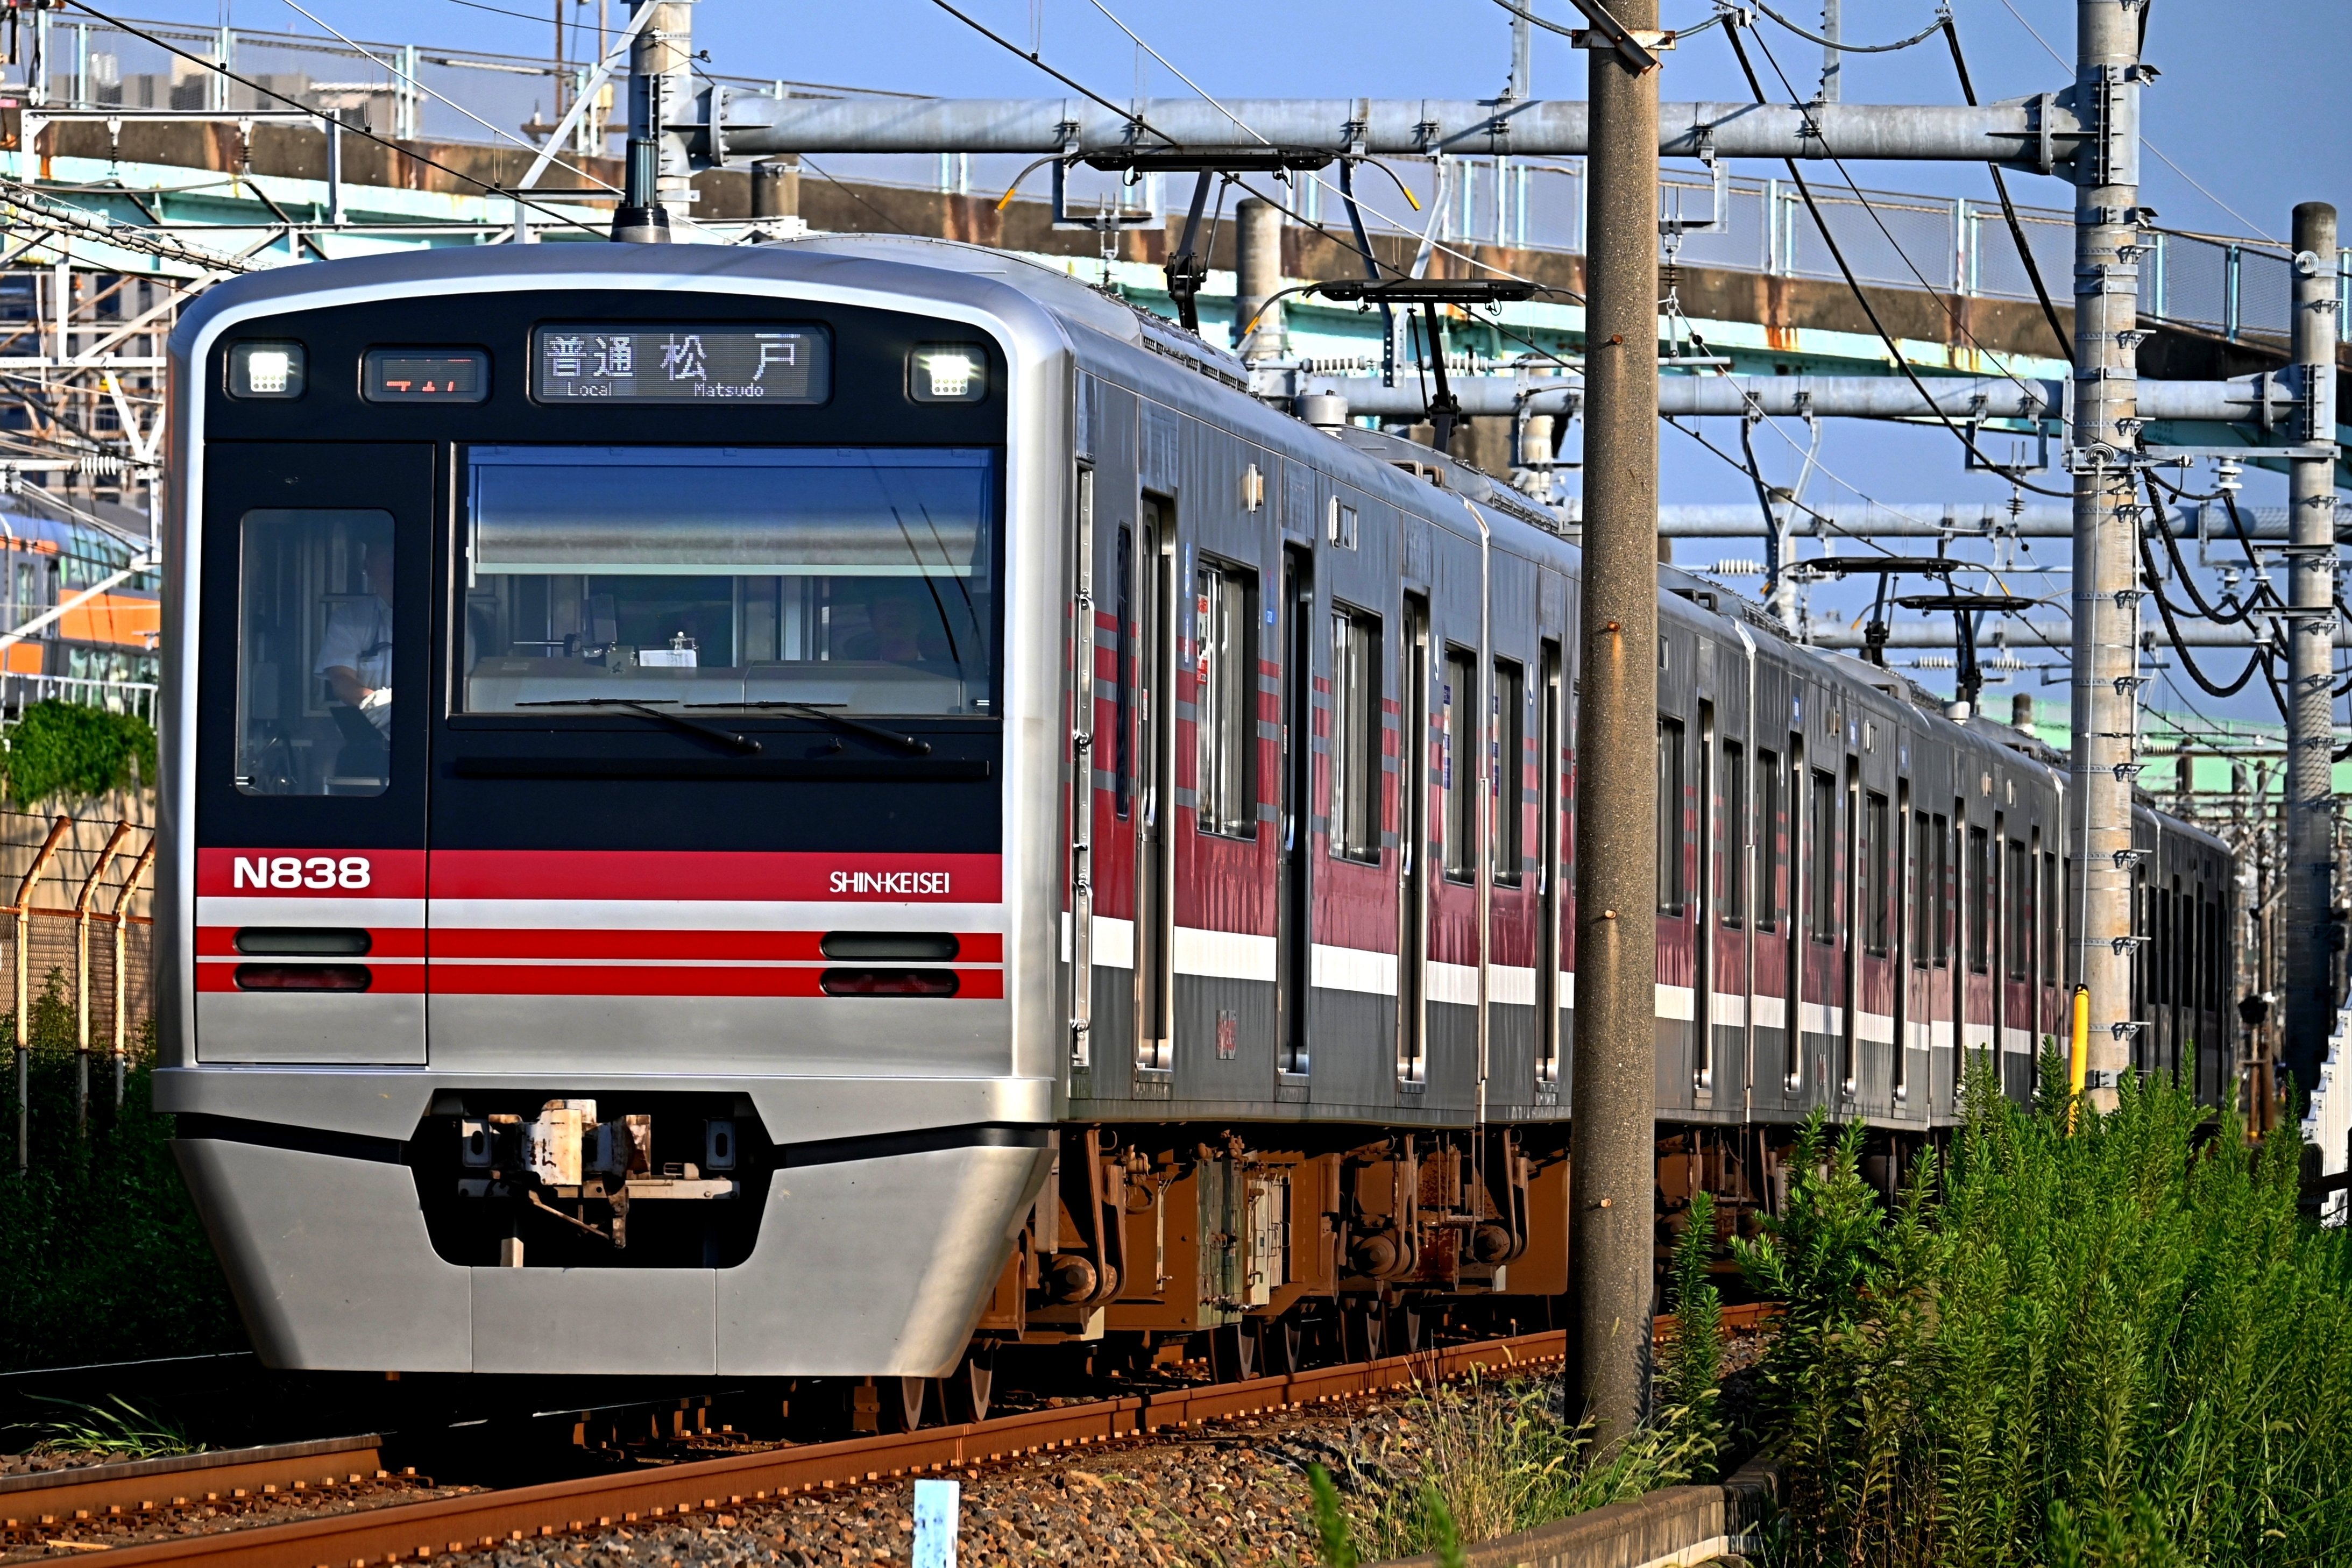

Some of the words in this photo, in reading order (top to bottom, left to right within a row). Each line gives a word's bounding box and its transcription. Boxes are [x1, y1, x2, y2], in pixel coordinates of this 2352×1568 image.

[547, 337, 633, 377] 普通
[660, 334, 800, 381] 松戸
[568, 382, 612, 396] Local
[694, 382, 764, 397] Matsudo
[233, 856, 371, 889] N838
